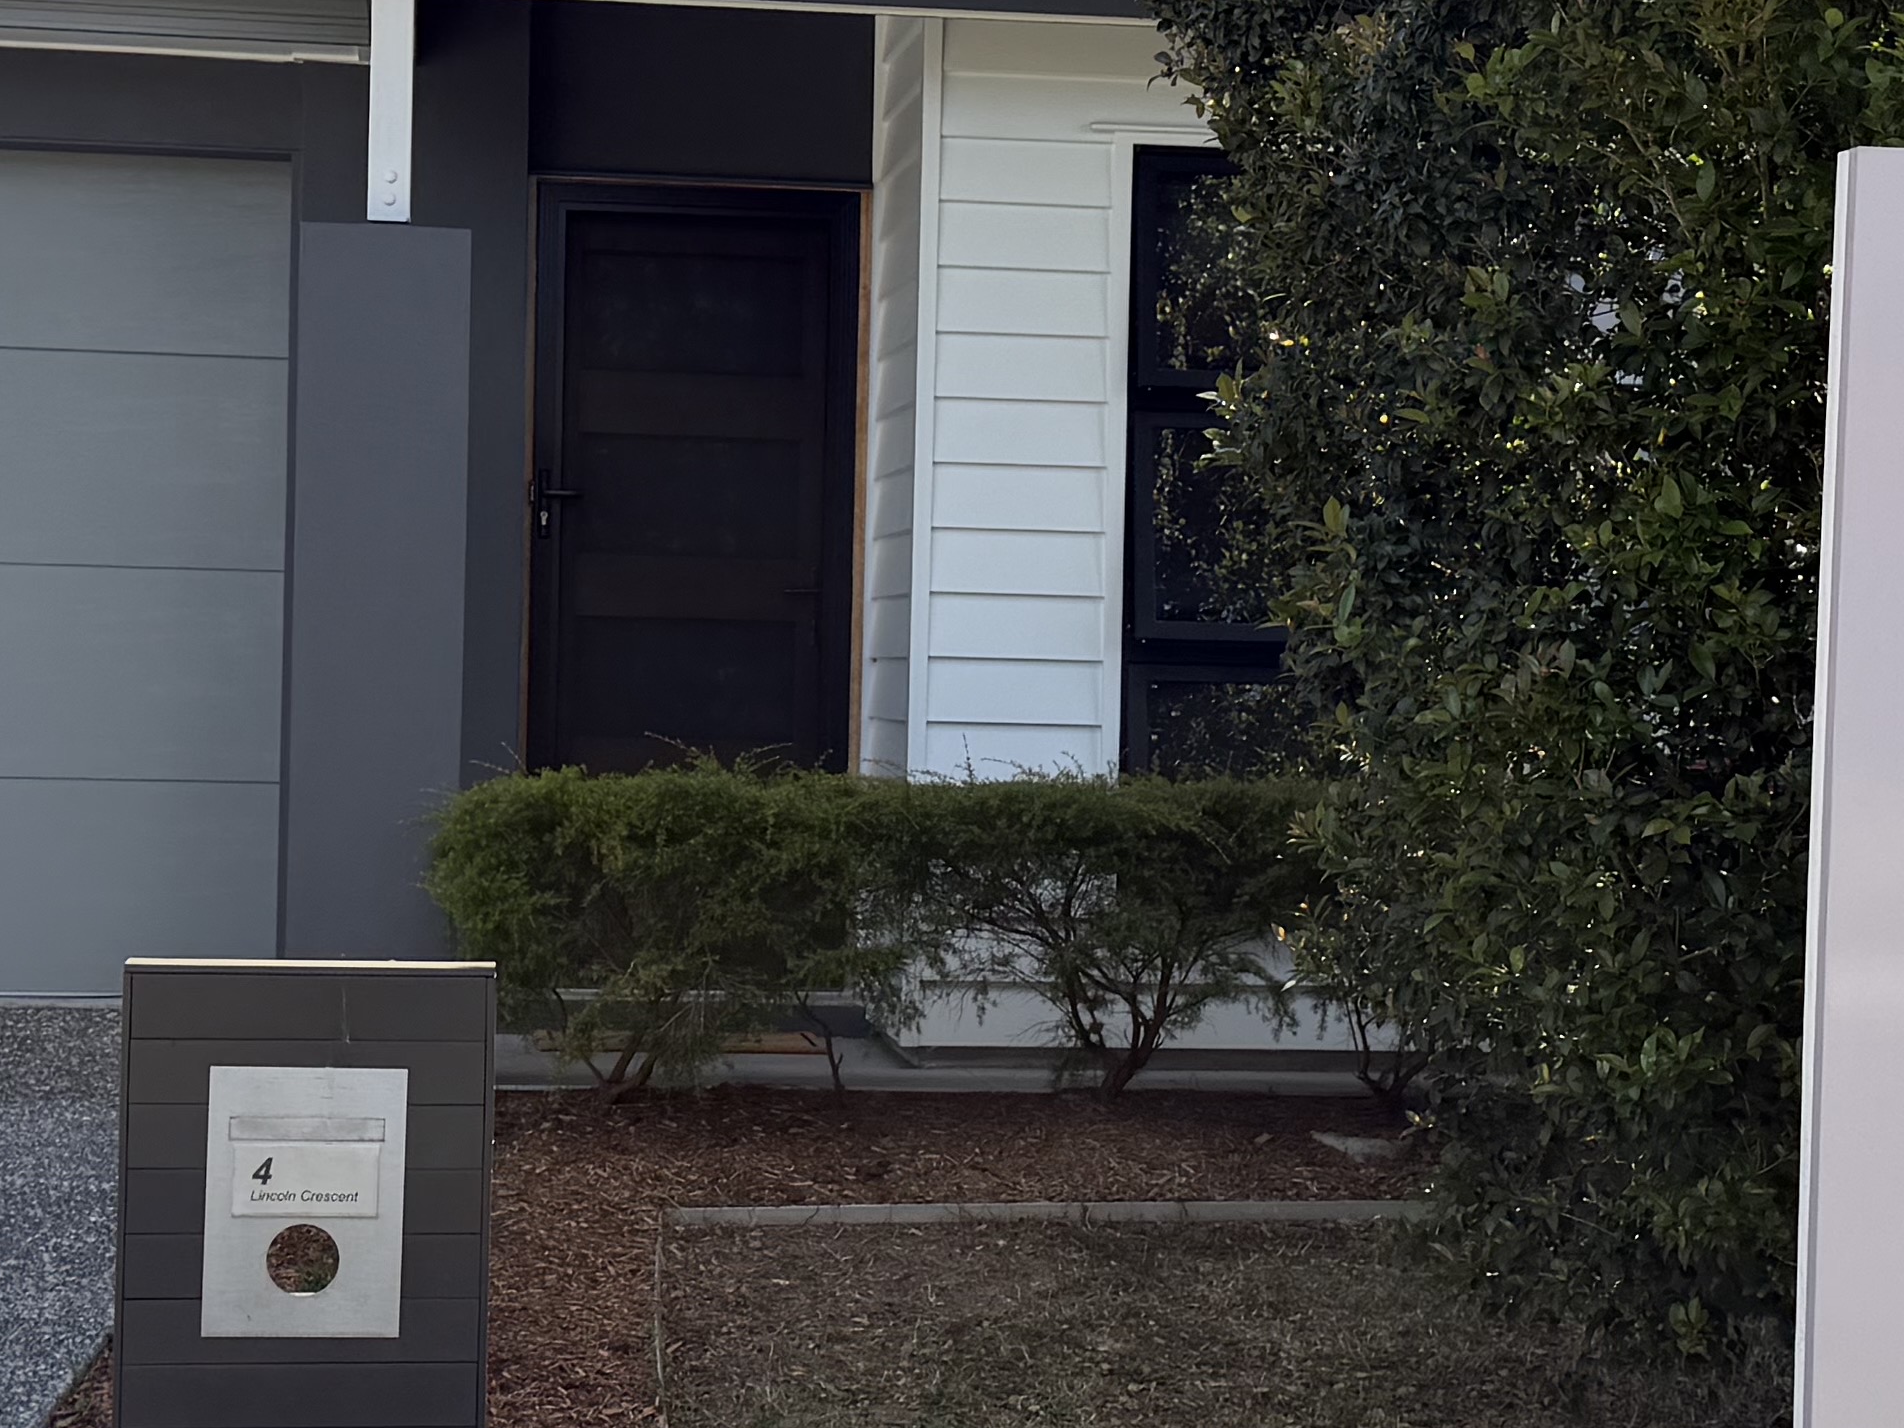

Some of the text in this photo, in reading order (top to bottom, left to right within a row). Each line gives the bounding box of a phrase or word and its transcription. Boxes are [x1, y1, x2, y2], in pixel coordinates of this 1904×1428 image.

[251, 1156, 274, 1186] 4
[250, 1189, 359, 1203] Lincoln Crescent
